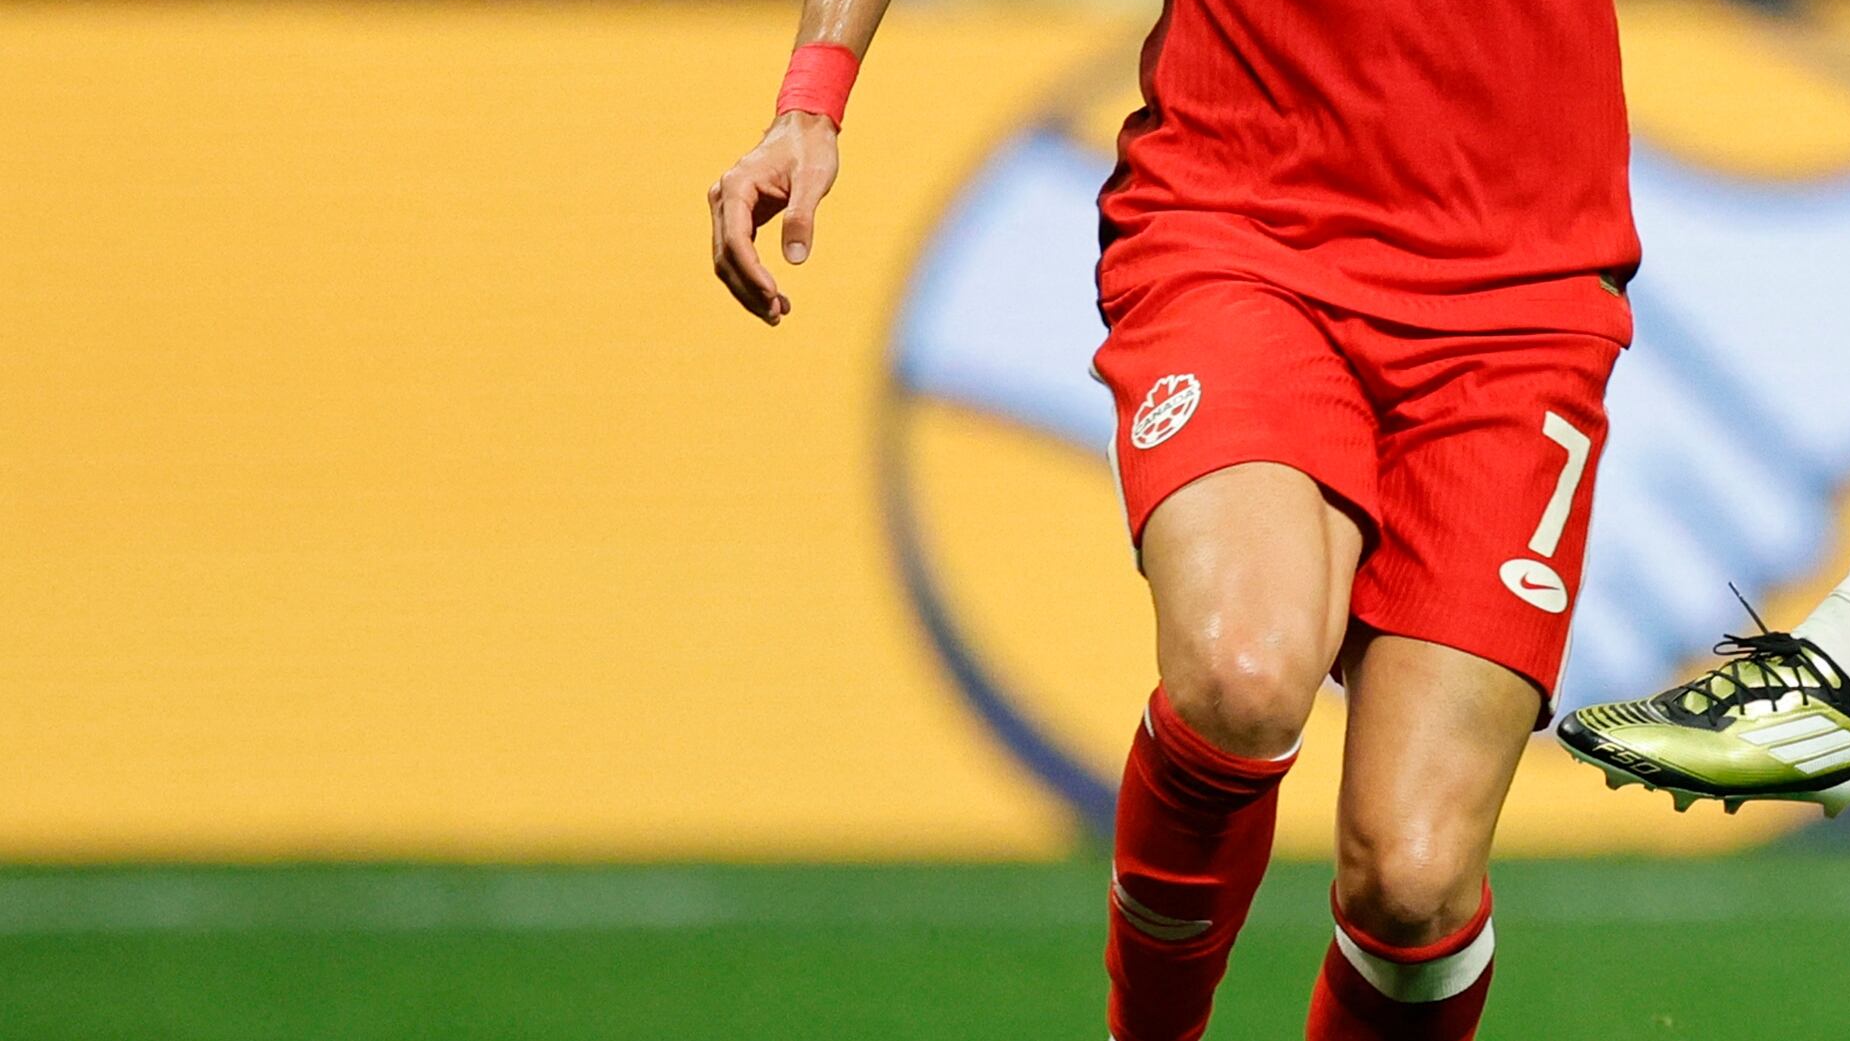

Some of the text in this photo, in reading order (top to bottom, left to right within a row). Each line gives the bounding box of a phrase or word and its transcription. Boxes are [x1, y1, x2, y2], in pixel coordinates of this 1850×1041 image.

[1134, 389, 1195, 437] CANADA
[1528, 410, 1592, 558] 7
[1592, 742, 1662, 775] F50
